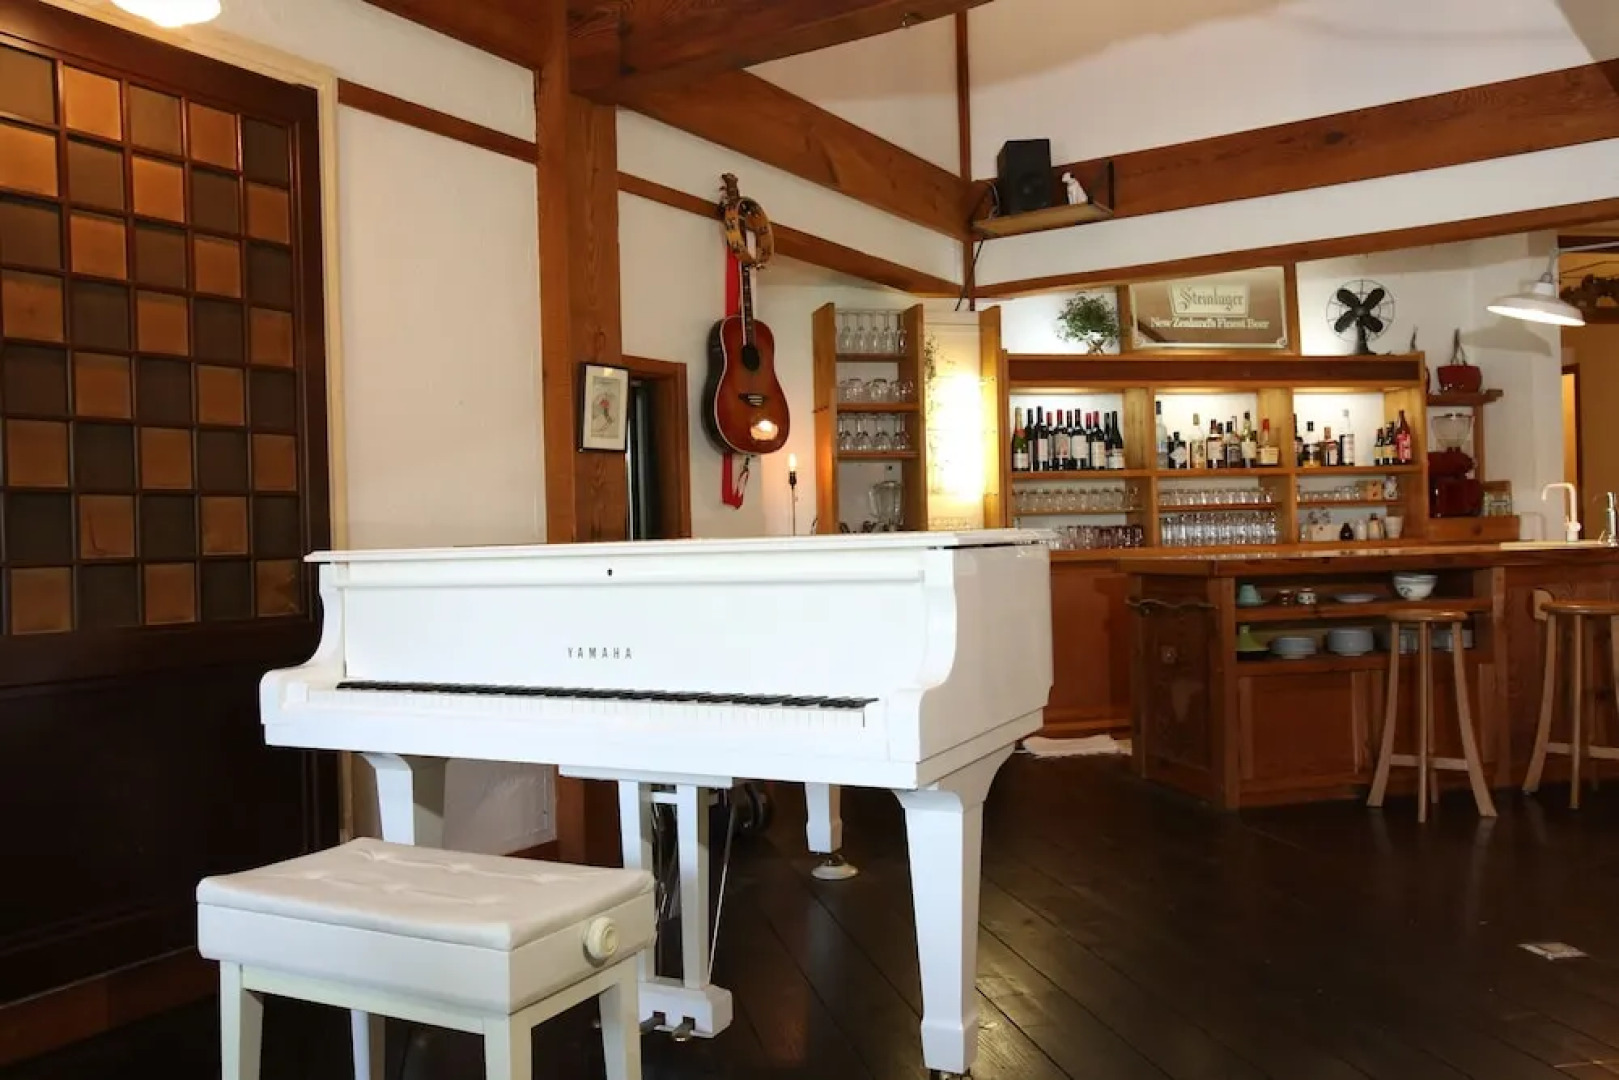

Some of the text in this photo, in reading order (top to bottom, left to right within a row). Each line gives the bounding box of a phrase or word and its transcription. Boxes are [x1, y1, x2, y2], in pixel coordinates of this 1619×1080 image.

[1178, 286, 1243, 311] Steinlager
[1150, 317, 1172, 328] New
[1217, 318, 1245, 329] Finest
[1246, 318, 1270, 329] Beer
[567, 647, 632, 659] YAMAHA
